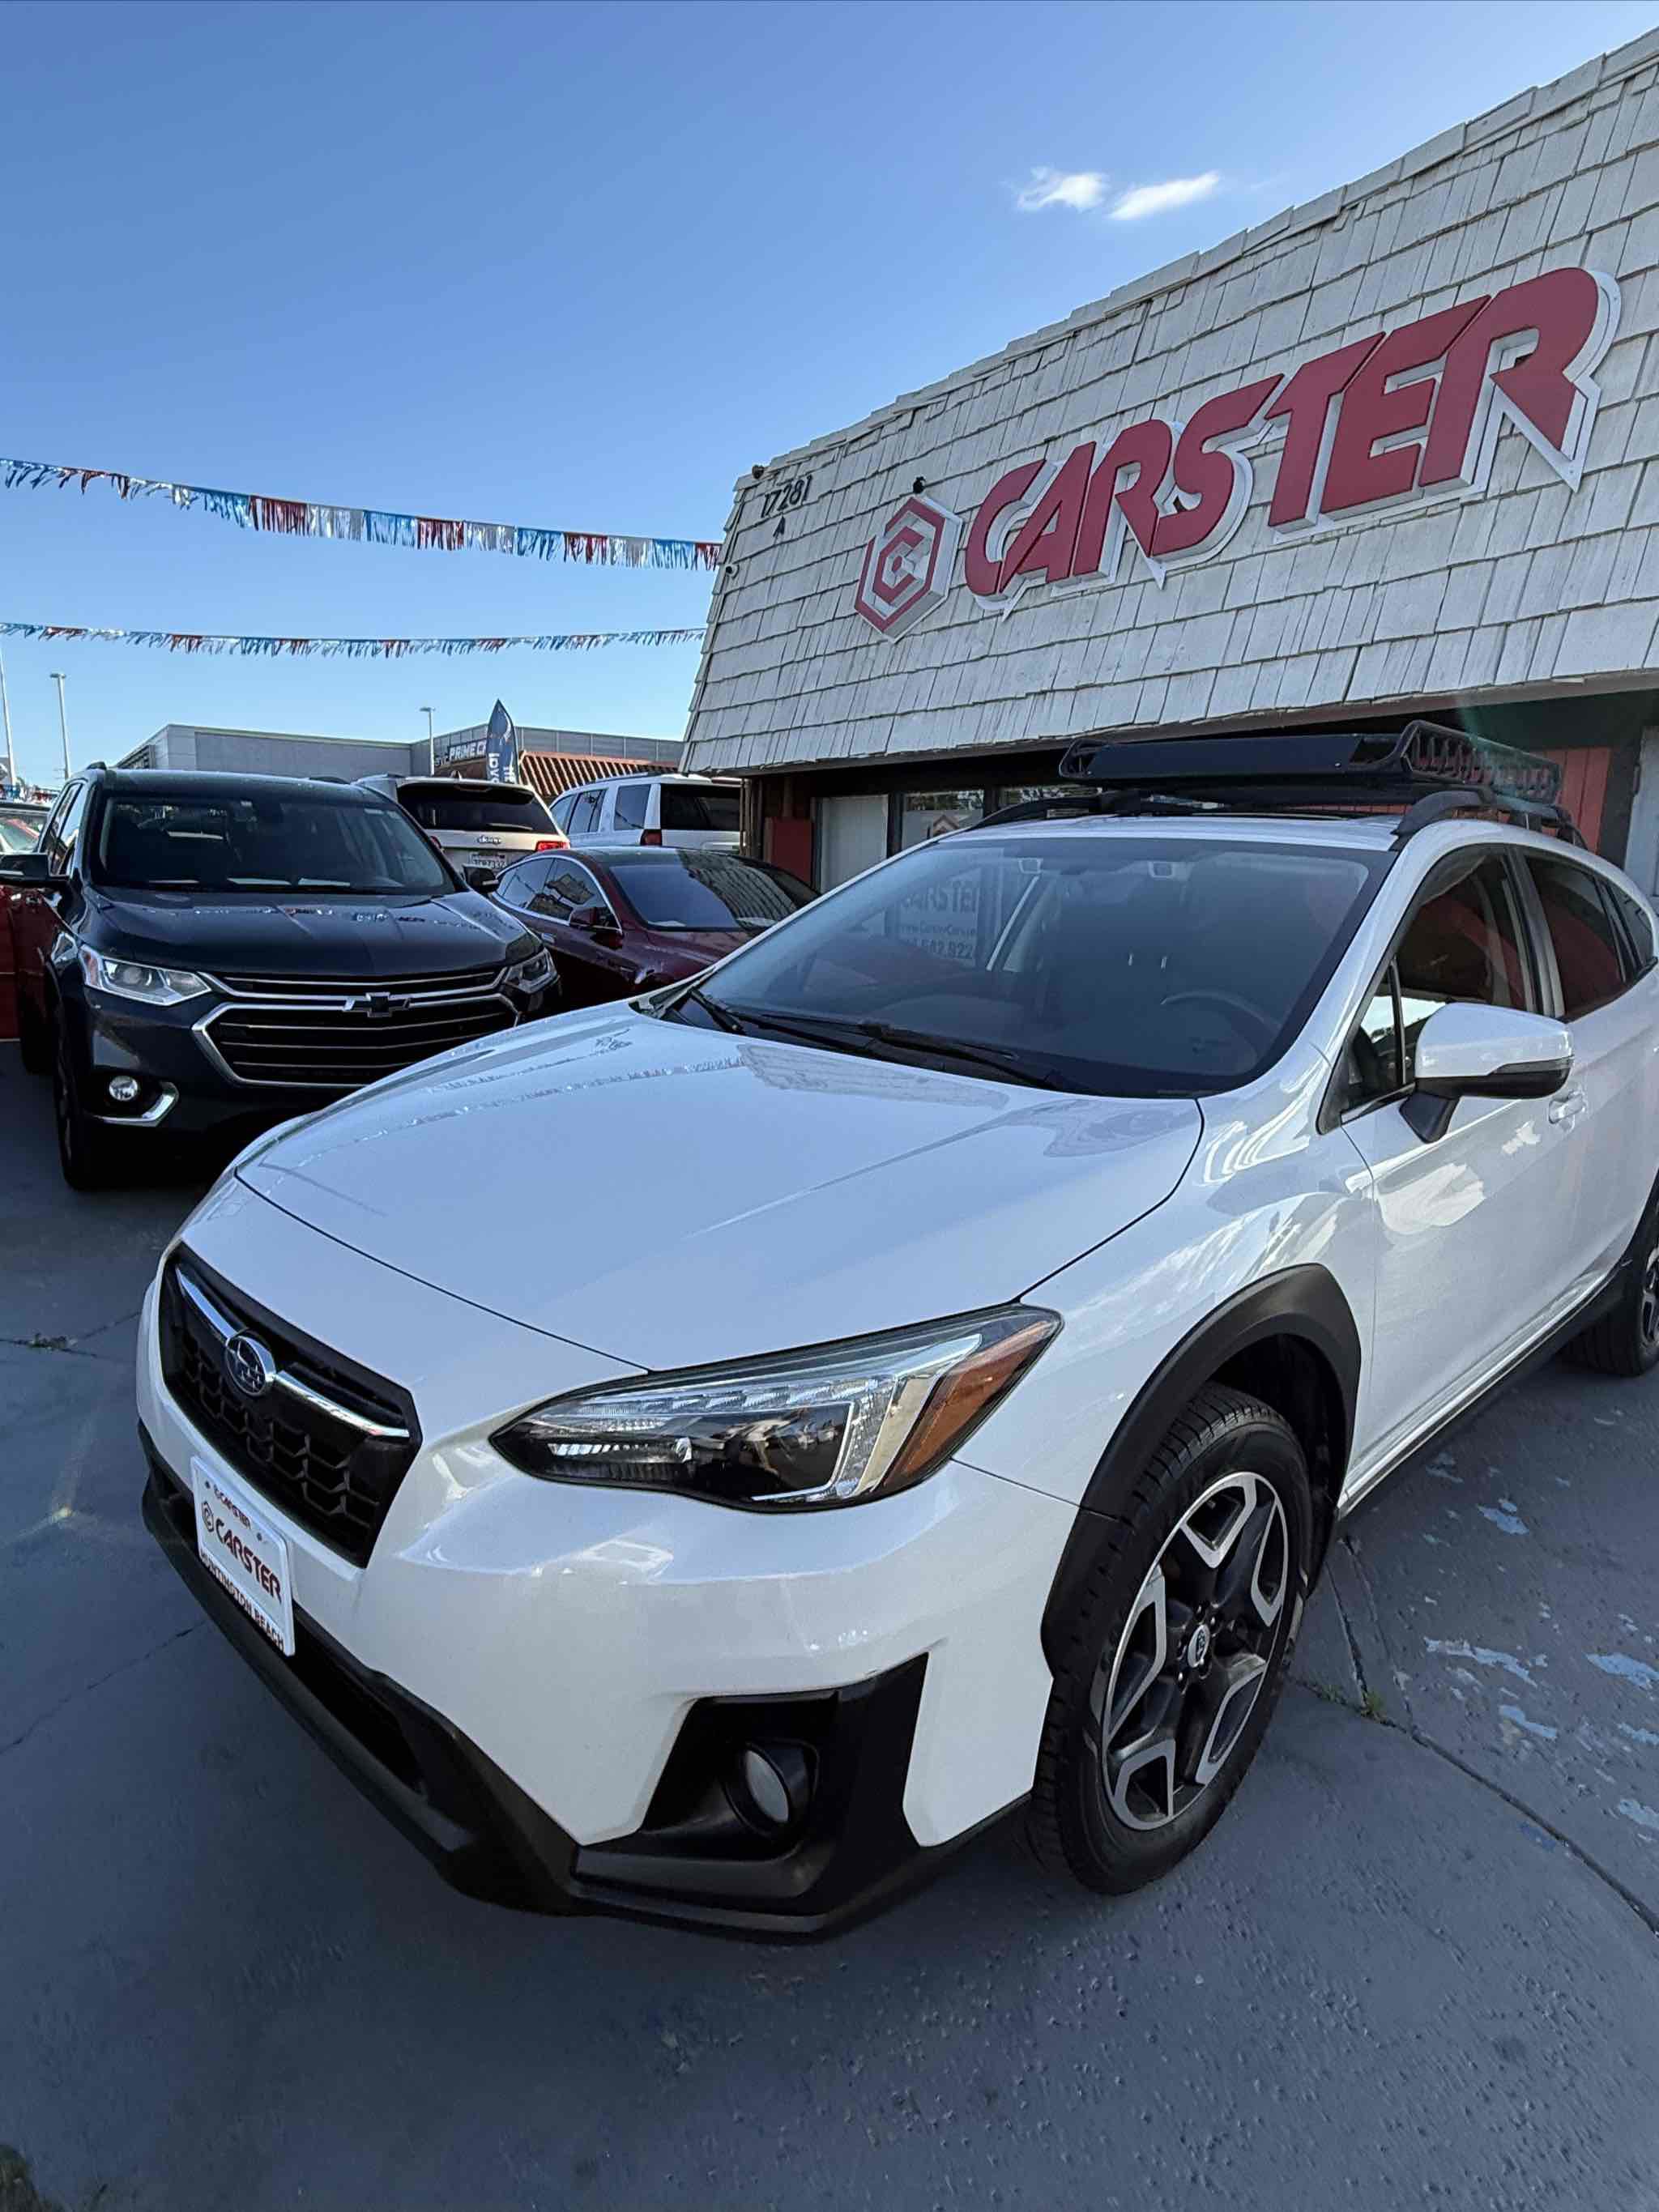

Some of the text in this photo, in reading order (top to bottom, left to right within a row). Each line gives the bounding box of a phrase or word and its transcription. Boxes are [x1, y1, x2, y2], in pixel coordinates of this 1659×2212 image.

[964, 268, 1606, 599] CARSTER
[761, 475, 812, 518] 17281
[450, 742, 476, 761] PRIME
[215, 1519, 282, 1604] CARSTER
